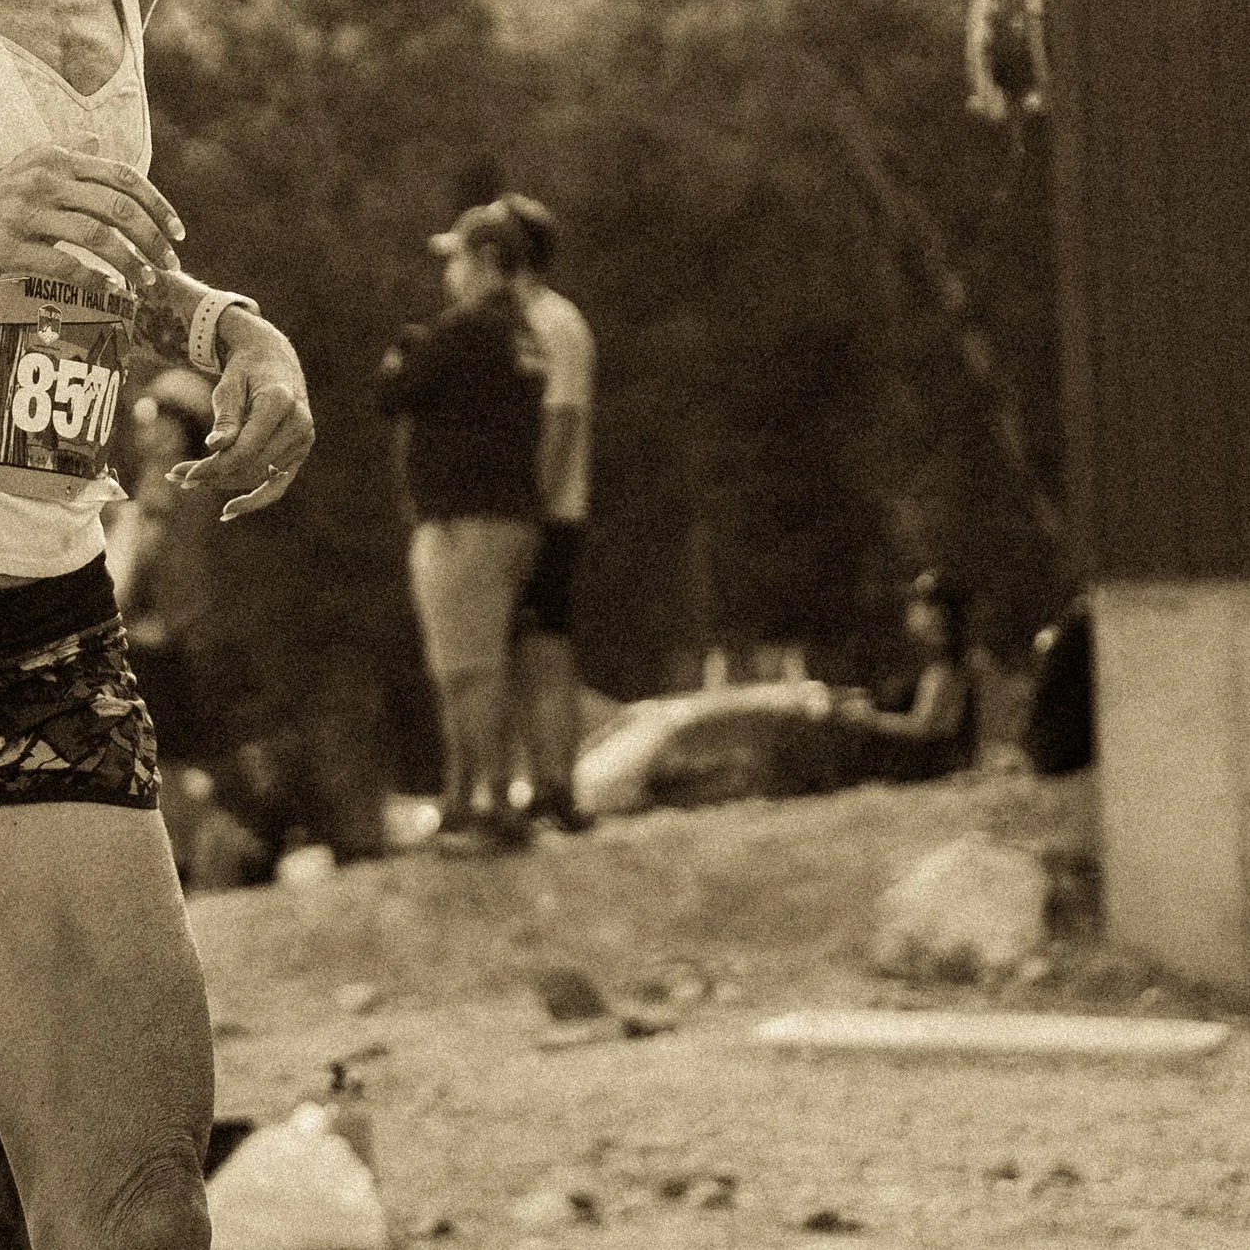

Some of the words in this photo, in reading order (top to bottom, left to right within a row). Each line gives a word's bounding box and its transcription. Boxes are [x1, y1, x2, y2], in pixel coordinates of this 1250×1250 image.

[24, 275, 78, 306] WASATCH
[81, 289, 106, 312] TRAIL
[11, 352, 120, 447] 8570
